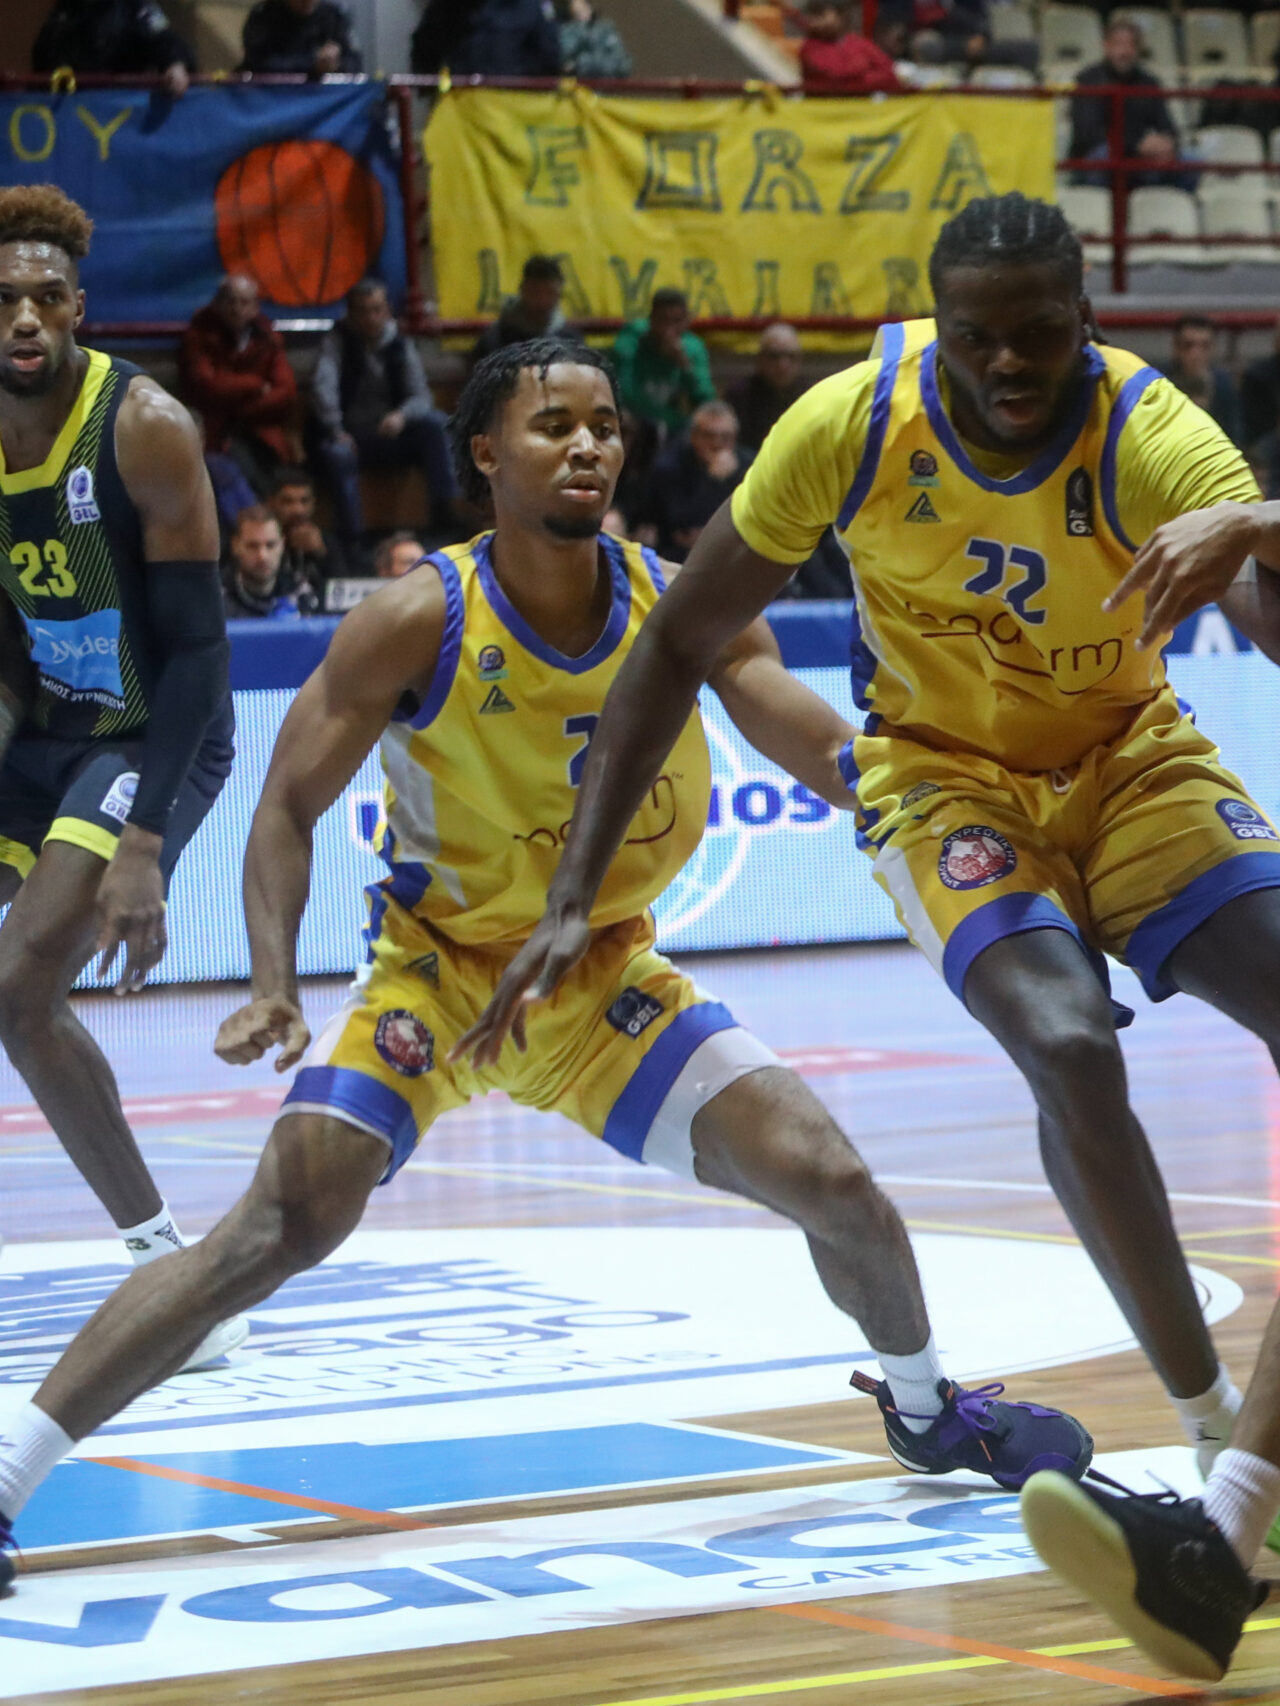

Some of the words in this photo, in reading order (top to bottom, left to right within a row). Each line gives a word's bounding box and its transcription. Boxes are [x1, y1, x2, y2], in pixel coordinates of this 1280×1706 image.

[524, 124, 994, 214] FORZA
[9, 538, 78, 598] 23
[962, 535, 1049, 626] 22
[1236, 828, 1280, 841] GBL
[627, 1003, 661, 1035] GBL
[148, 1345, 588, 1395] UILDING
[737, 1562, 933, 1590] CAR
[936, 1544, 1040, 1567] RE
